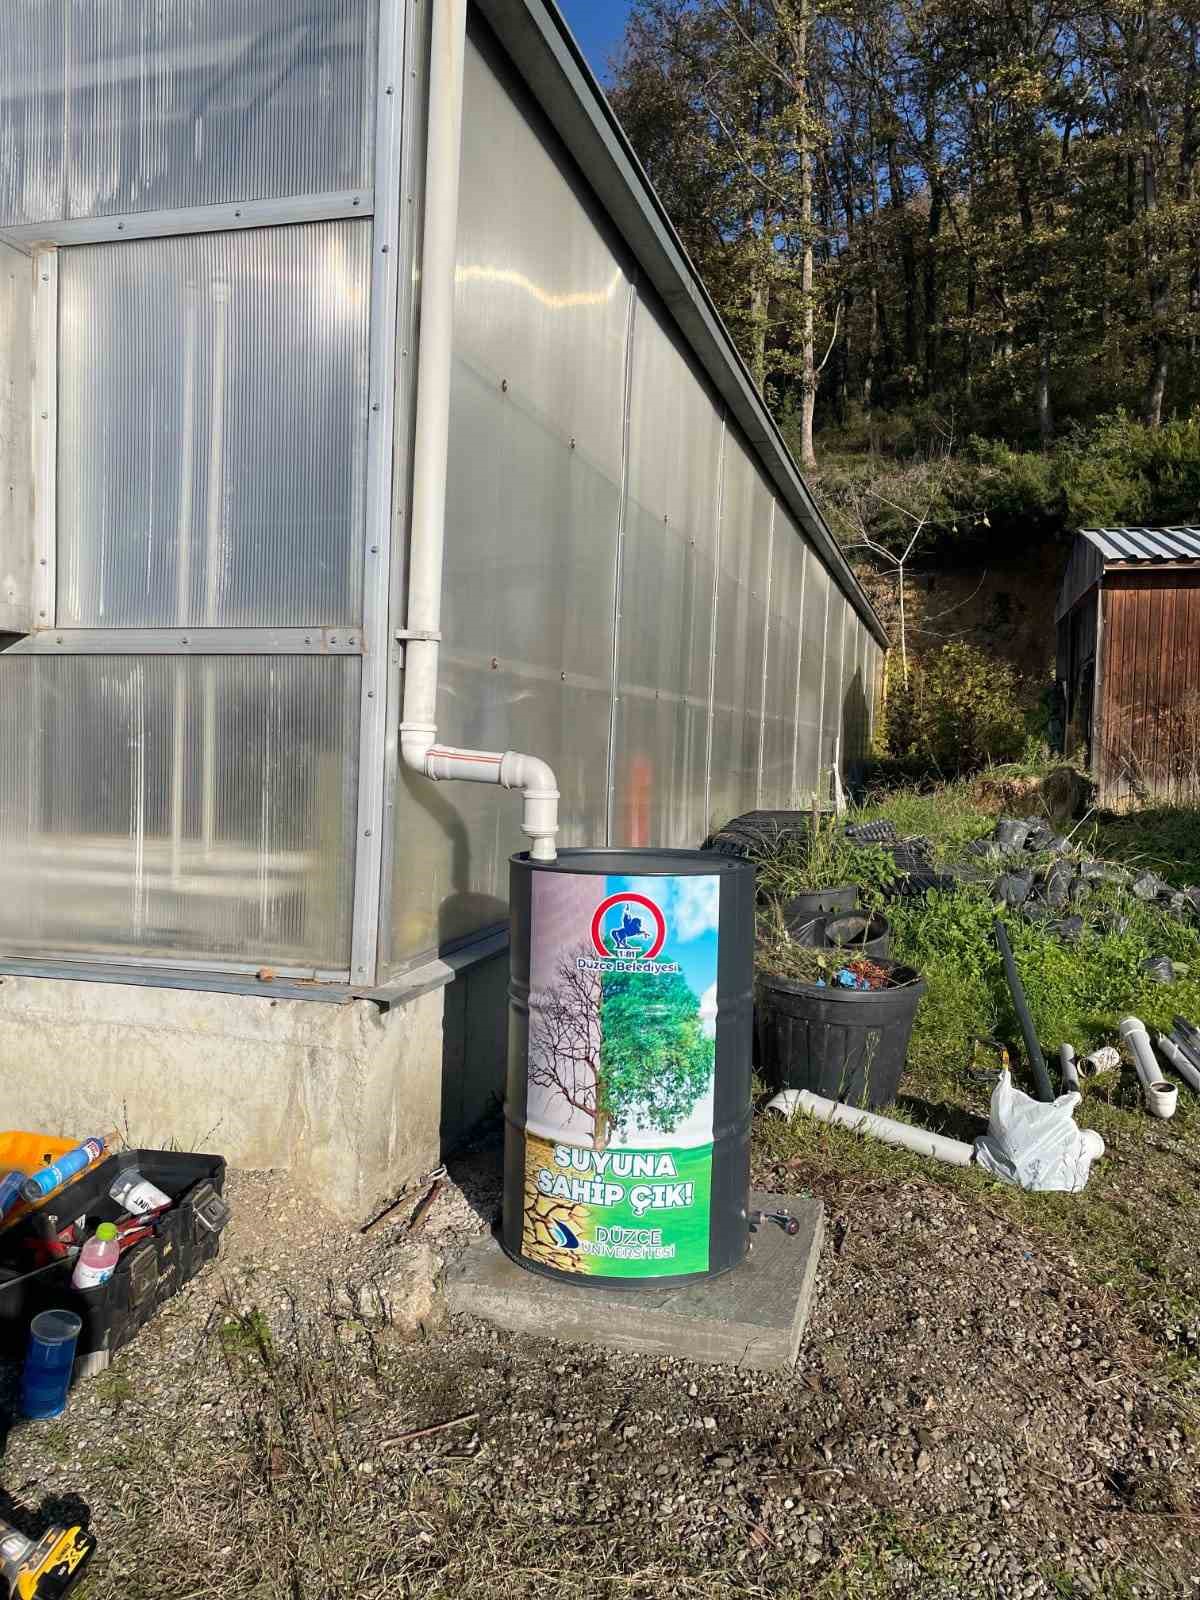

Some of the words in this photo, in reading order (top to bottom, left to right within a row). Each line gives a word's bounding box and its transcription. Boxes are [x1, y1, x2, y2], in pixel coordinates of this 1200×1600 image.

[616, 961, 679, 975] Belediyesi
[554, 1144, 677, 1177] SUYUNA
[537, 1168, 624, 1206] SAHİP
[630, 1181, 694, 1216] ÇIK!
[596, 1226, 662, 1245] DÜZCE
